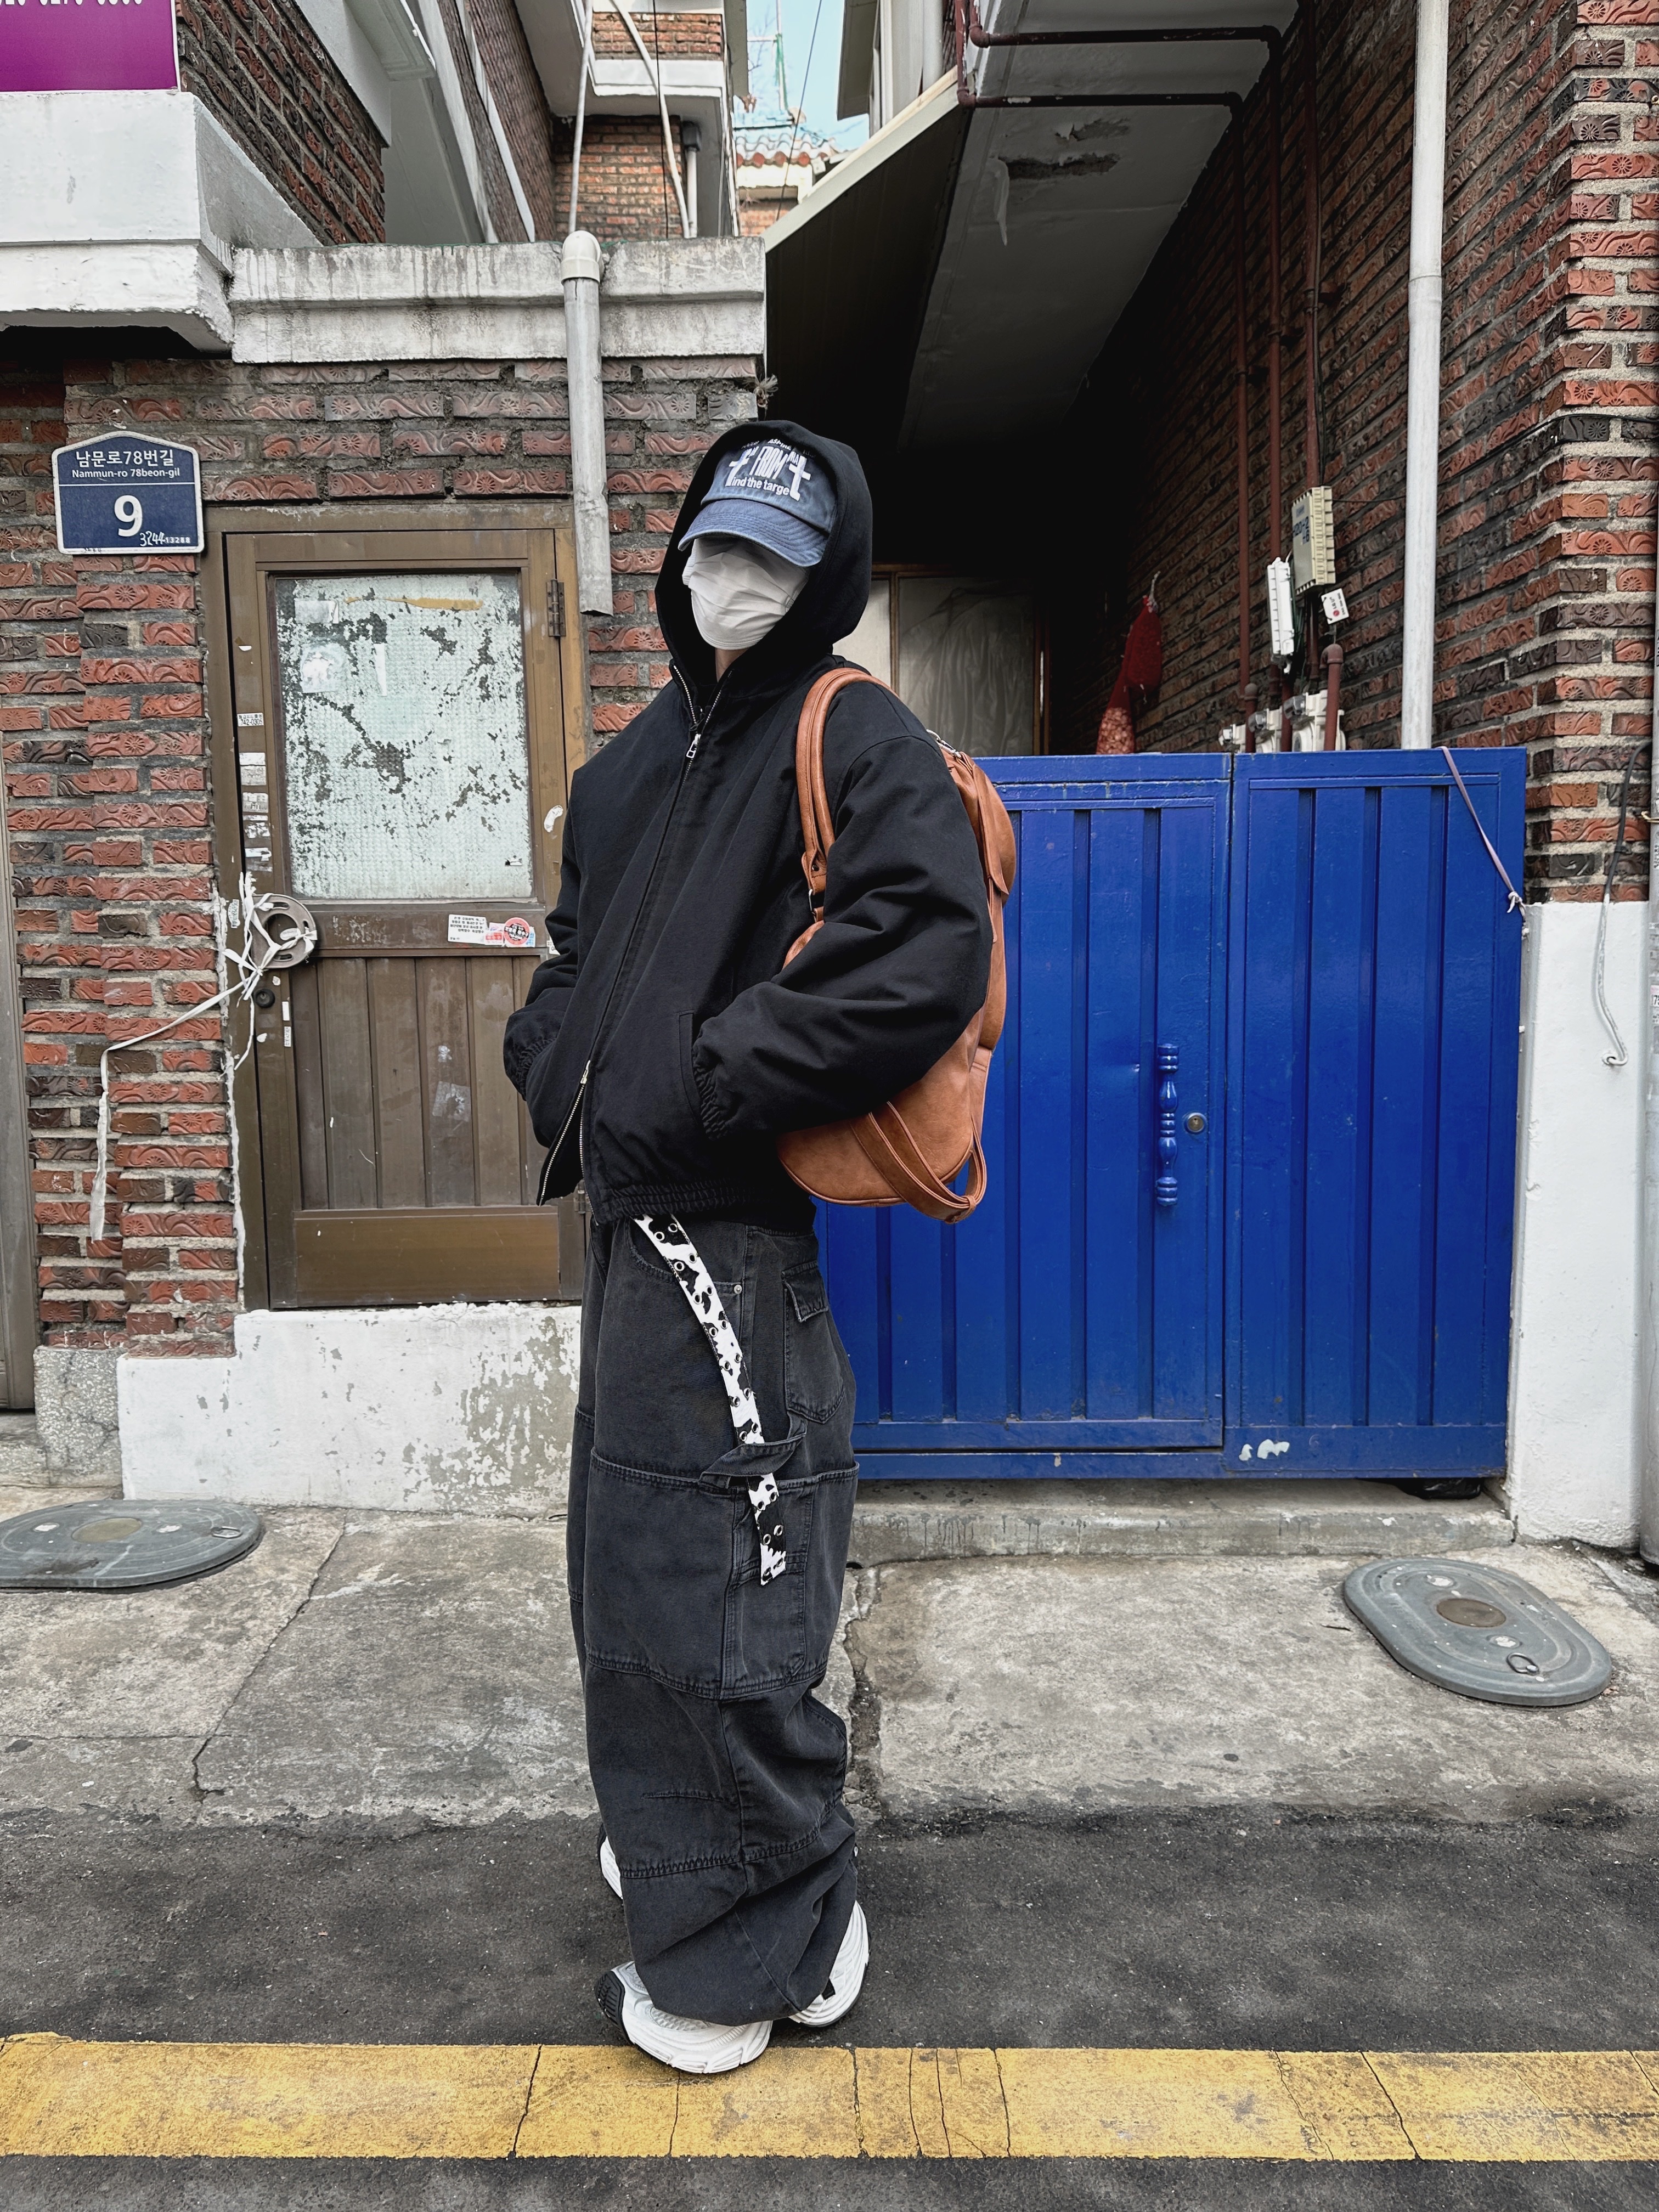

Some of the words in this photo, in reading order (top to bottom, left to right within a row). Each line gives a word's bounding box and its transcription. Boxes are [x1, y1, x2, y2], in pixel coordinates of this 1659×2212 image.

[76, 449, 174, 468] 남문로78번길
[749, 445, 789, 480] FROM
[72, 469, 128, 478] Nammun-ro
[130, 467, 180, 478] 78beon-gil
[747, 477, 763, 489] the
[114, 495, 143, 537] 9
